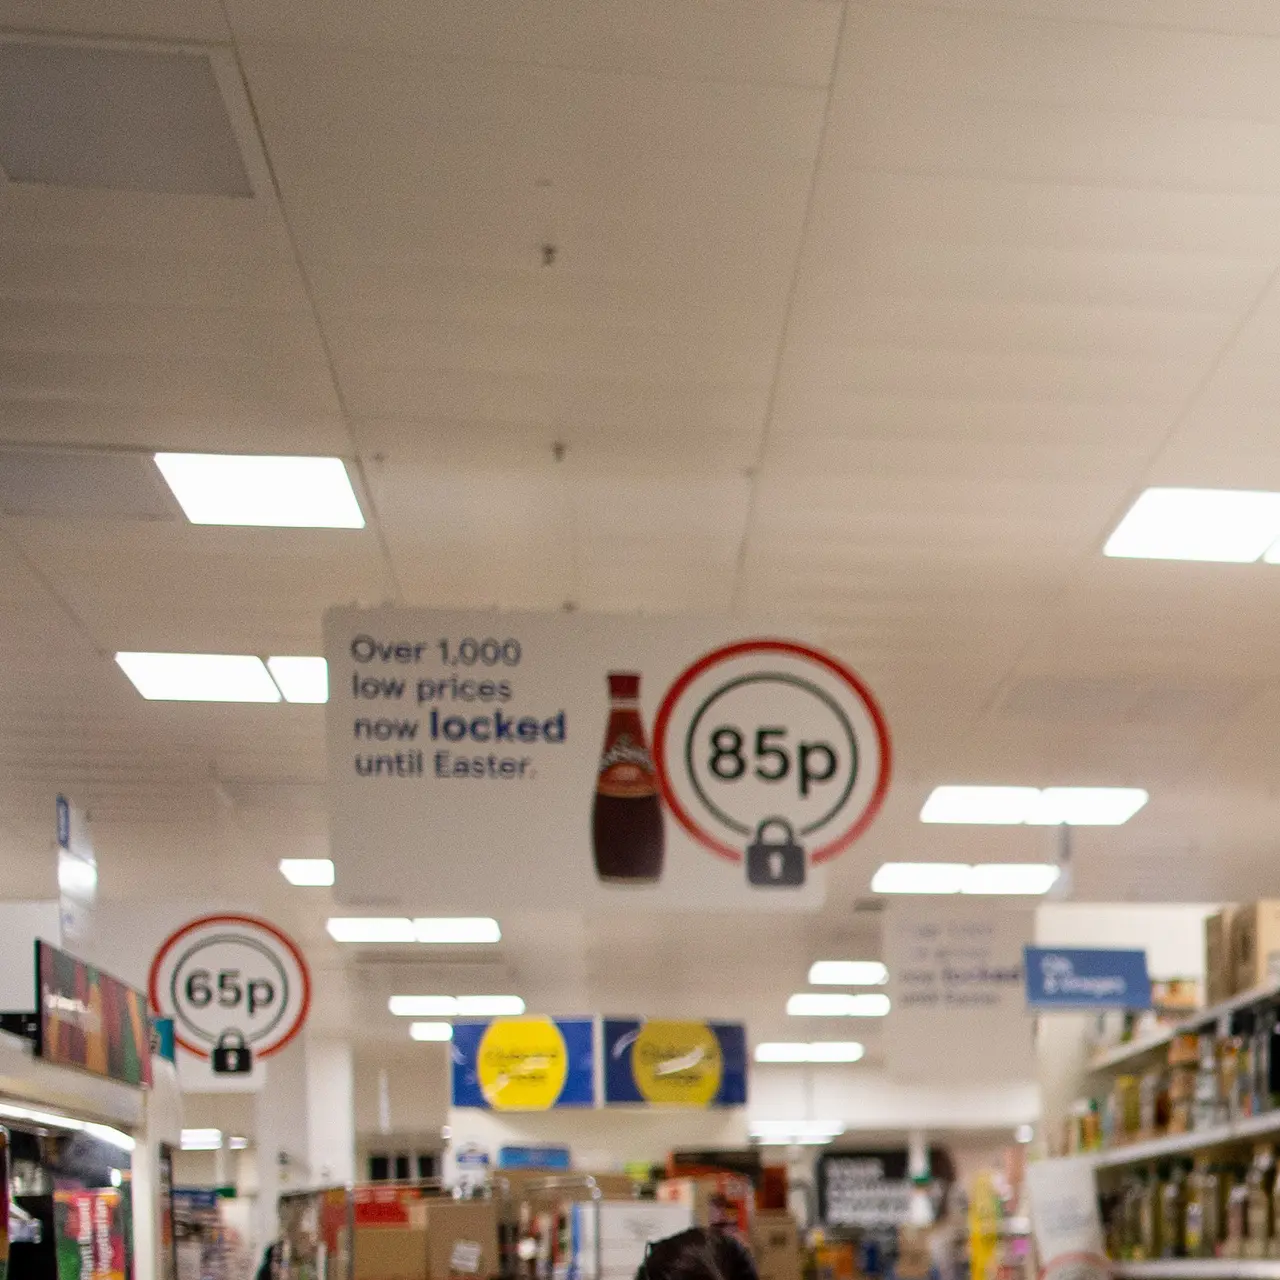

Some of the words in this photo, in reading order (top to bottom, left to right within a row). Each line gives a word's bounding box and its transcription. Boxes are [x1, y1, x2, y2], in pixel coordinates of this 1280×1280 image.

[351, 634, 425, 665] Over
[352, 674, 403, 698] low
[416, 677, 513, 703] prices
[354, 719, 417, 741] now
[429, 711, 567, 743] locked
[355, 753, 424, 778] until
[708, 726, 838, 798] 85p
[186, 969, 275, 1015] 65p
